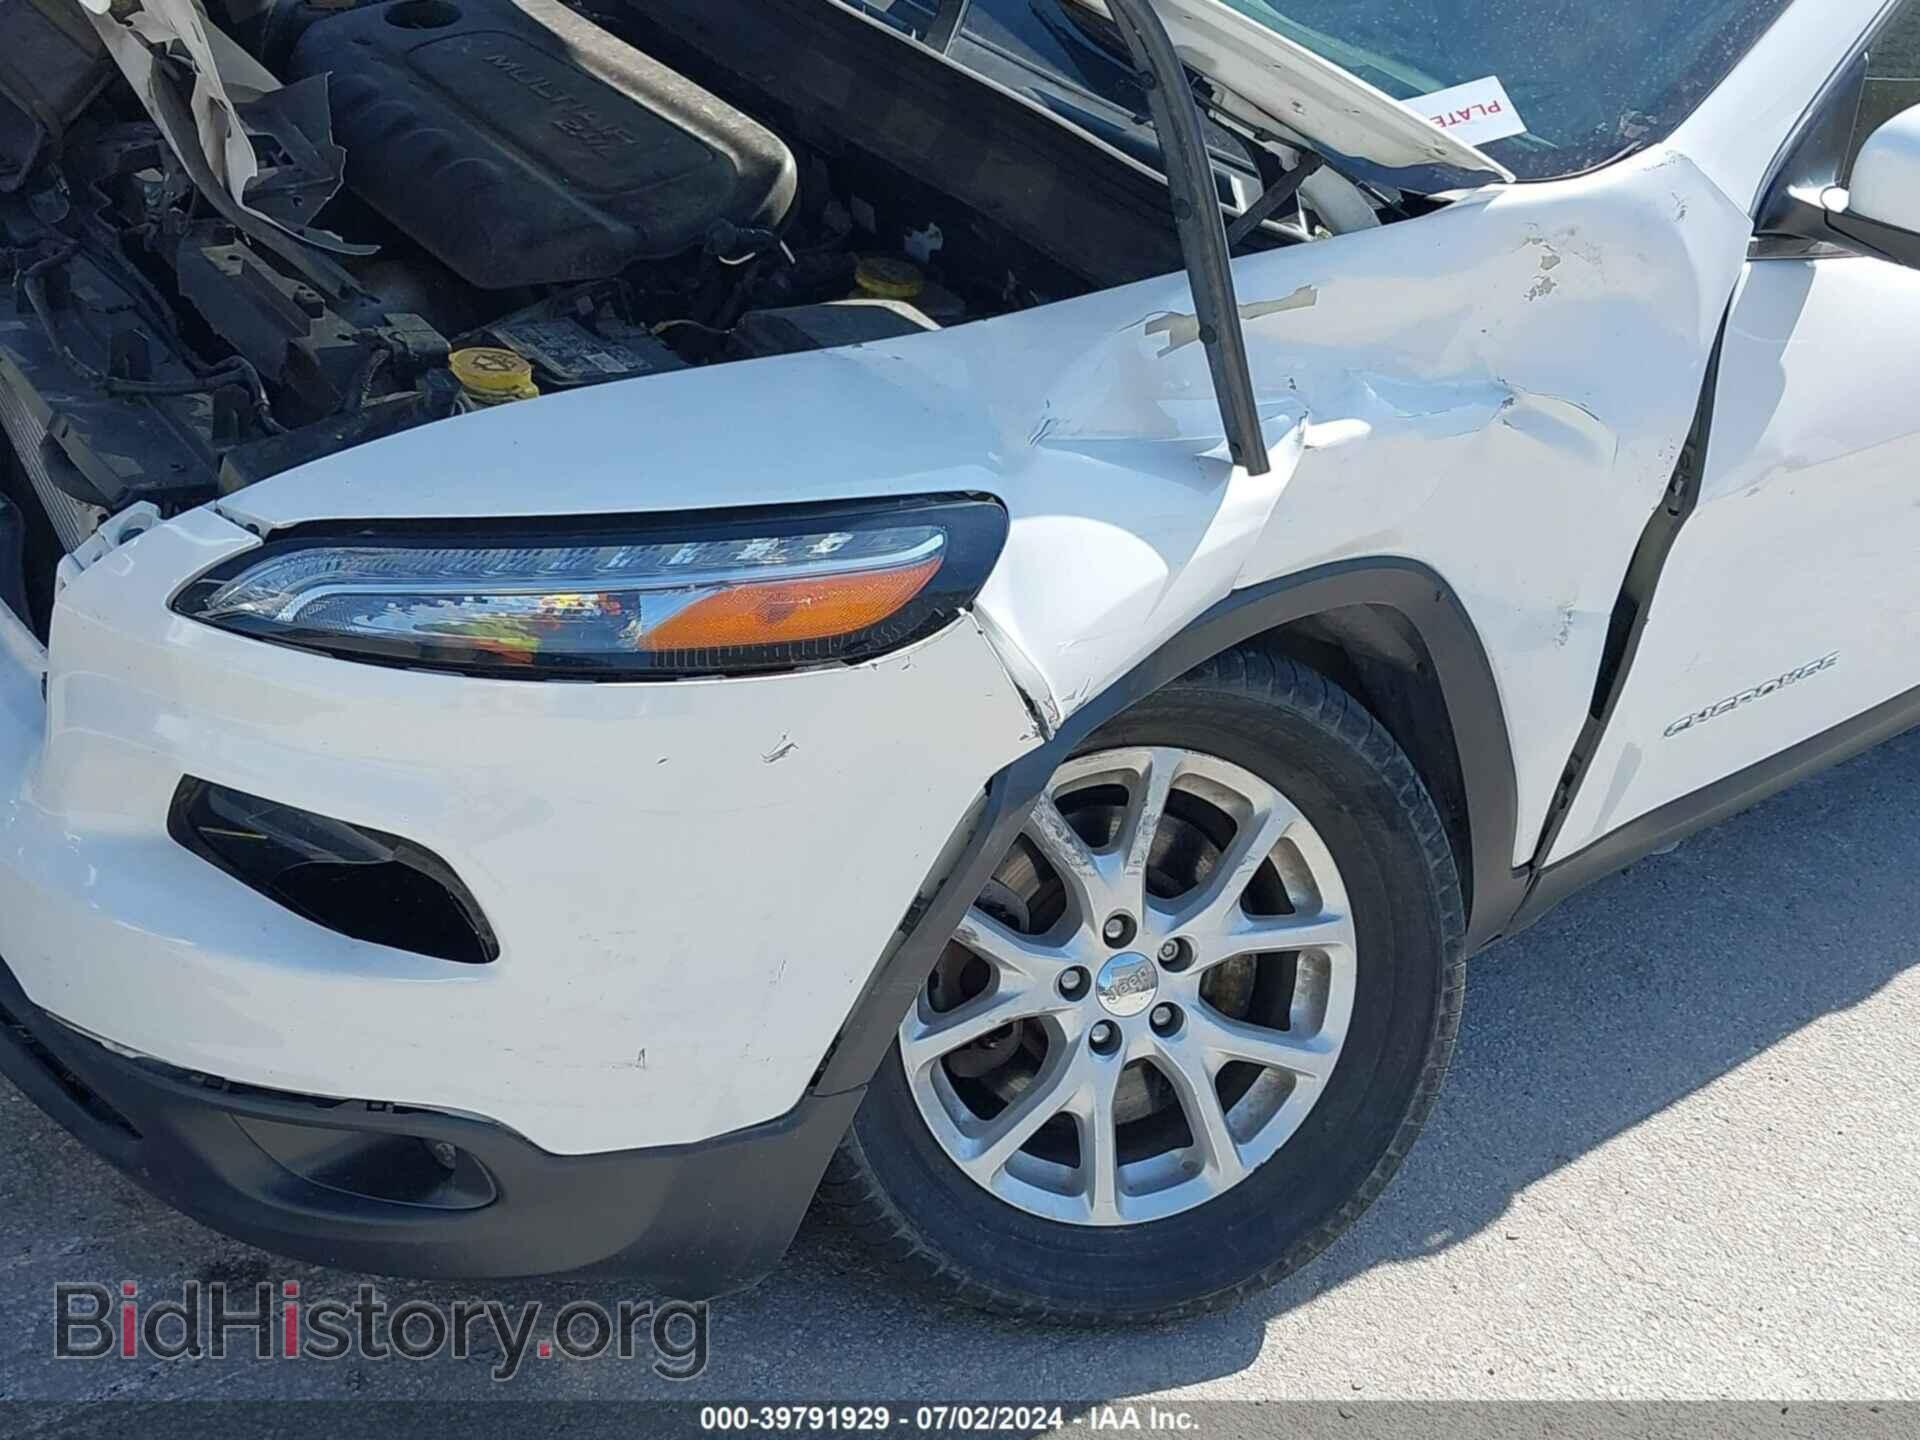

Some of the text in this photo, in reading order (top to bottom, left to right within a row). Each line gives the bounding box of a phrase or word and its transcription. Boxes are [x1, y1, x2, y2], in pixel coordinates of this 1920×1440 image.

[1430, 100, 1502, 128] PLATE
[1663, 650, 1840, 737] CHEROKEE
[1106, 967, 1149, 1004] Jeep
